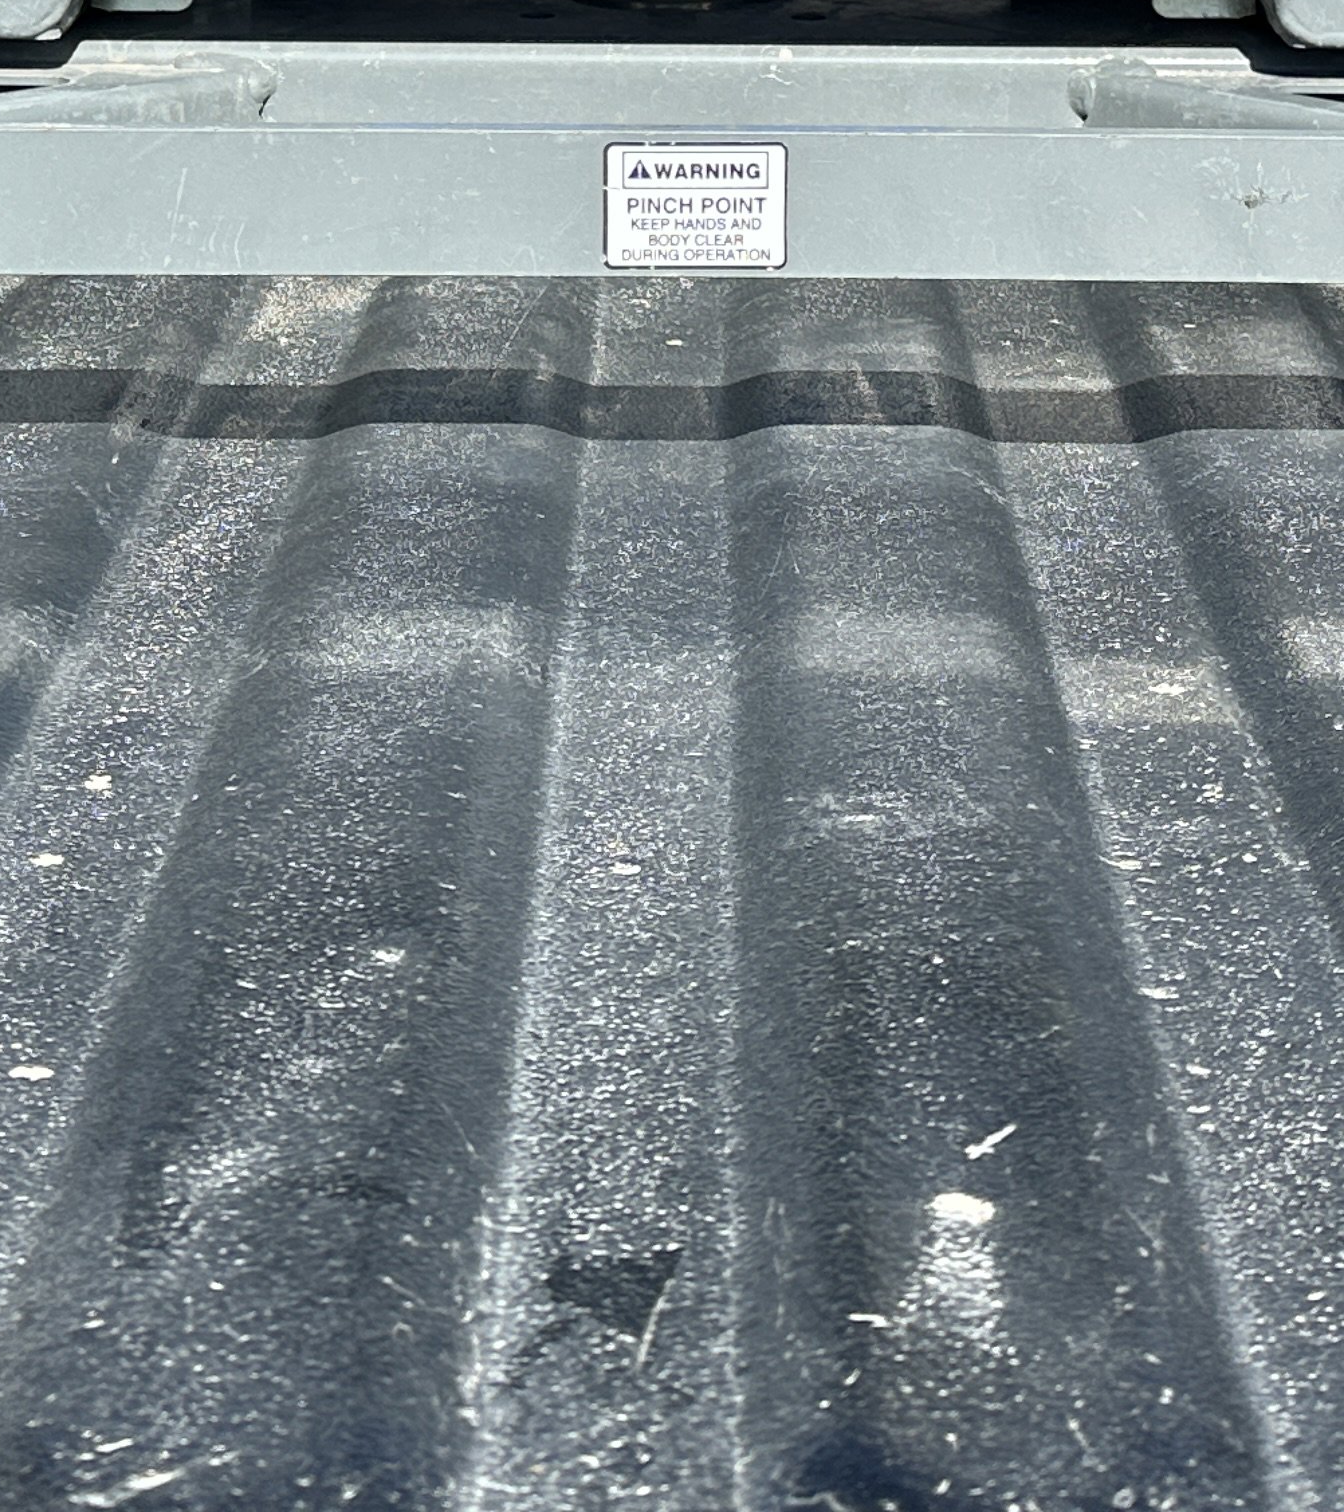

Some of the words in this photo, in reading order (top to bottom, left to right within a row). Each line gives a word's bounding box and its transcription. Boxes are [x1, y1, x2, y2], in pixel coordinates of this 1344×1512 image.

[654, 163, 761, 180] WARNING
[627, 197, 693, 214] PINCH
[701, 197, 767, 214] POINT
[631, 218, 670, 230] KEEP
[674, 218, 726, 230] HANDS
[730, 218, 762, 230] AND
[648, 234, 691, 246] BODY
[695, 234, 744, 246] CLEAR
[621, 249, 679, 261] DURING
[684, 249, 771, 261] OPERATION
